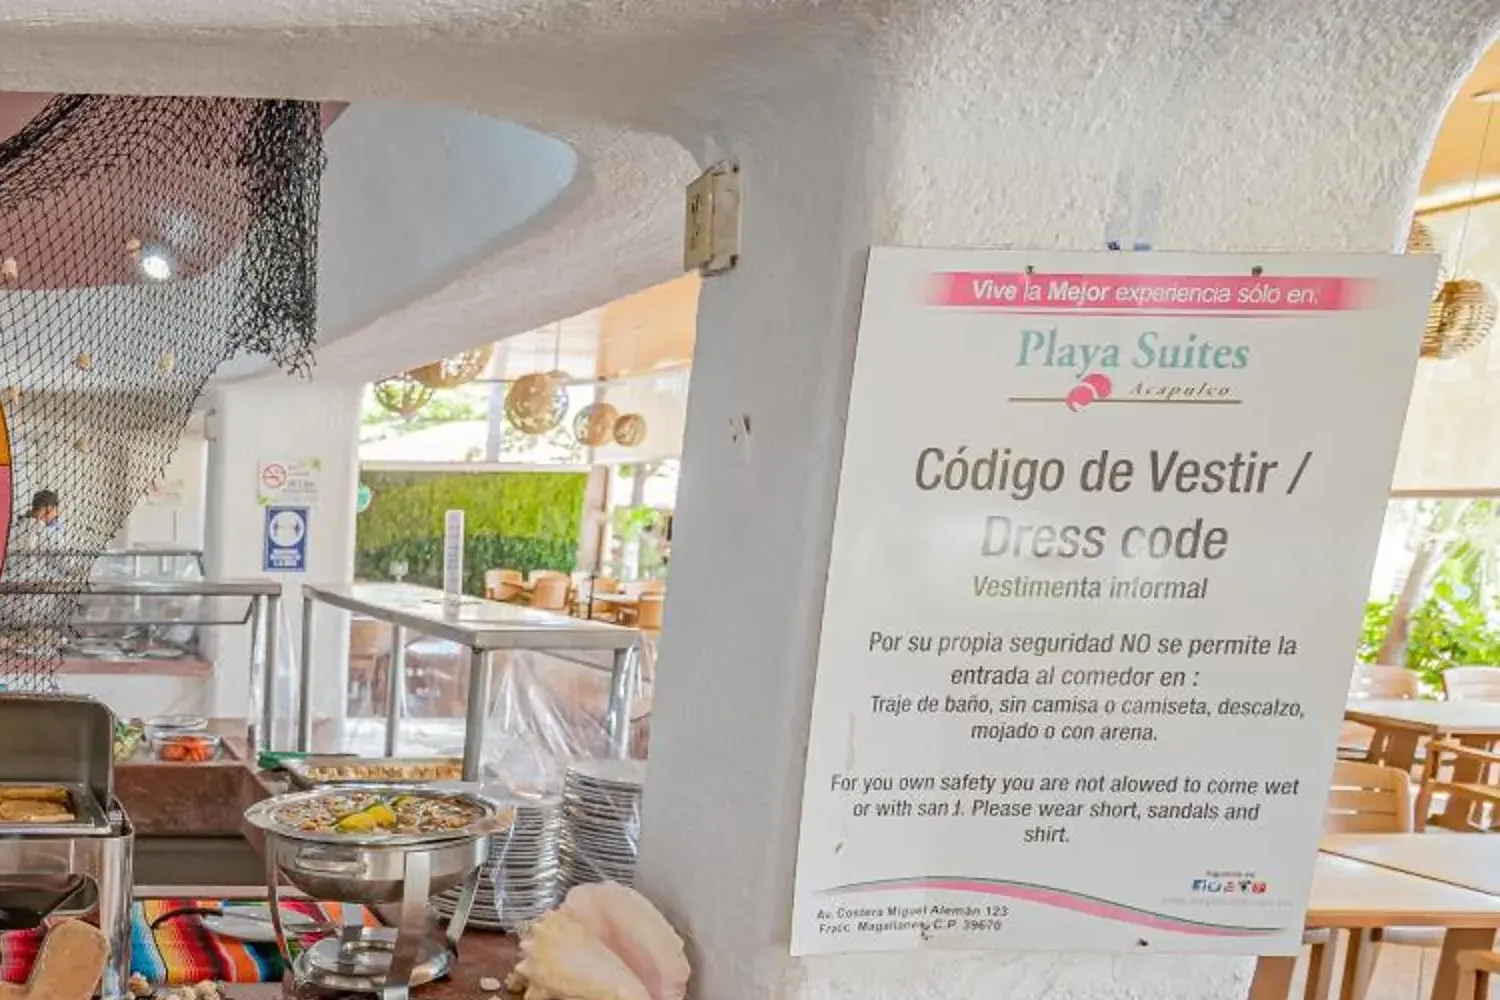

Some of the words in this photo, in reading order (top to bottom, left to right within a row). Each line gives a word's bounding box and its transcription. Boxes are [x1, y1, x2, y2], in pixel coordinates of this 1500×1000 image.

[972, 280, 1016, 300] Vive
[1024, 280, 1041, 300] la
[1048, 281, 1107, 304] Mejor
[1115, 285, 1231, 305] experiencia
[1236, 283, 1281, 303] sólo
[1016, 328, 1121, 379] Playa
[1132, 331, 1250, 369] Suites
[1129, 382, 1231, 400] Acapulco
[915, 446, 1065, 500] Código
[1080, 450, 1134, 492] de
[1149, 450, 1278, 494] Vestir
[1286, 451, 1312, 494] /
[980, 515, 1106, 558] Dress
[1121, 518, 1229, 560] code
[973, 576, 1101, 599] Vestimenta
[1109, 577, 1208, 599] informal
[869, 631, 902, 652] Por
[907, 634, 932, 652] su
[937, 632, 1003, 656] propia
[1009, 633, 1114, 656] seguridad
[1120, 634, 1151, 653] NO
[1157, 637, 1183, 654] se
[1187, 635, 1271, 658] permite
[1277, 636, 1297, 655] la
[950, 666, 1029, 685] entrada
[1035, 665, 1055, 685] al
[1061, 667, 1154, 686] comedor
[1160, 671, 1186, 686] en
[871, 695, 912, 716] Traje
[917, 696, 939, 713] de
[944, 695, 993, 715] baño,
[999, 696, 1026, 713] sin
[1032, 696, 1098, 713] camisa
[1104, 700, 1115, 714] o
[1121, 698, 1211, 717] camiseta,
[1218, 698, 1304, 718] descalzo,
[971, 722, 1039, 742] mojado
[1044, 725, 1055, 739] o
[1061, 725, 1094, 740] con
[1100, 726, 1157, 741] arena.
[831, 773, 858, 791] For
[862, 776, 893, 794] you
[900, 777, 935, 791] own
[939, 774, 996, 794] safety
[1001, 776, 1035, 794] you
[1039, 777, 1069, 791] are
[1075, 776, 1105, 792] not
[1110, 776, 1178, 792] alowed
[1183, 776, 1200, 792] to
[1207, 779, 1258, 794] come
[1265, 778, 1299, 795] wet
[853, 803, 871, 817] or
[876, 800, 912, 817] with
[971, 800, 1032, 817] Please
[1039, 802, 1083, 817] wear
[1089, 800, 1141, 820] short,
[1147, 802, 1219, 819] sandals
[1224, 803, 1260, 820] and
[1023, 826, 1069, 843] shirt.
[986, 905, 1009, 917] 123
